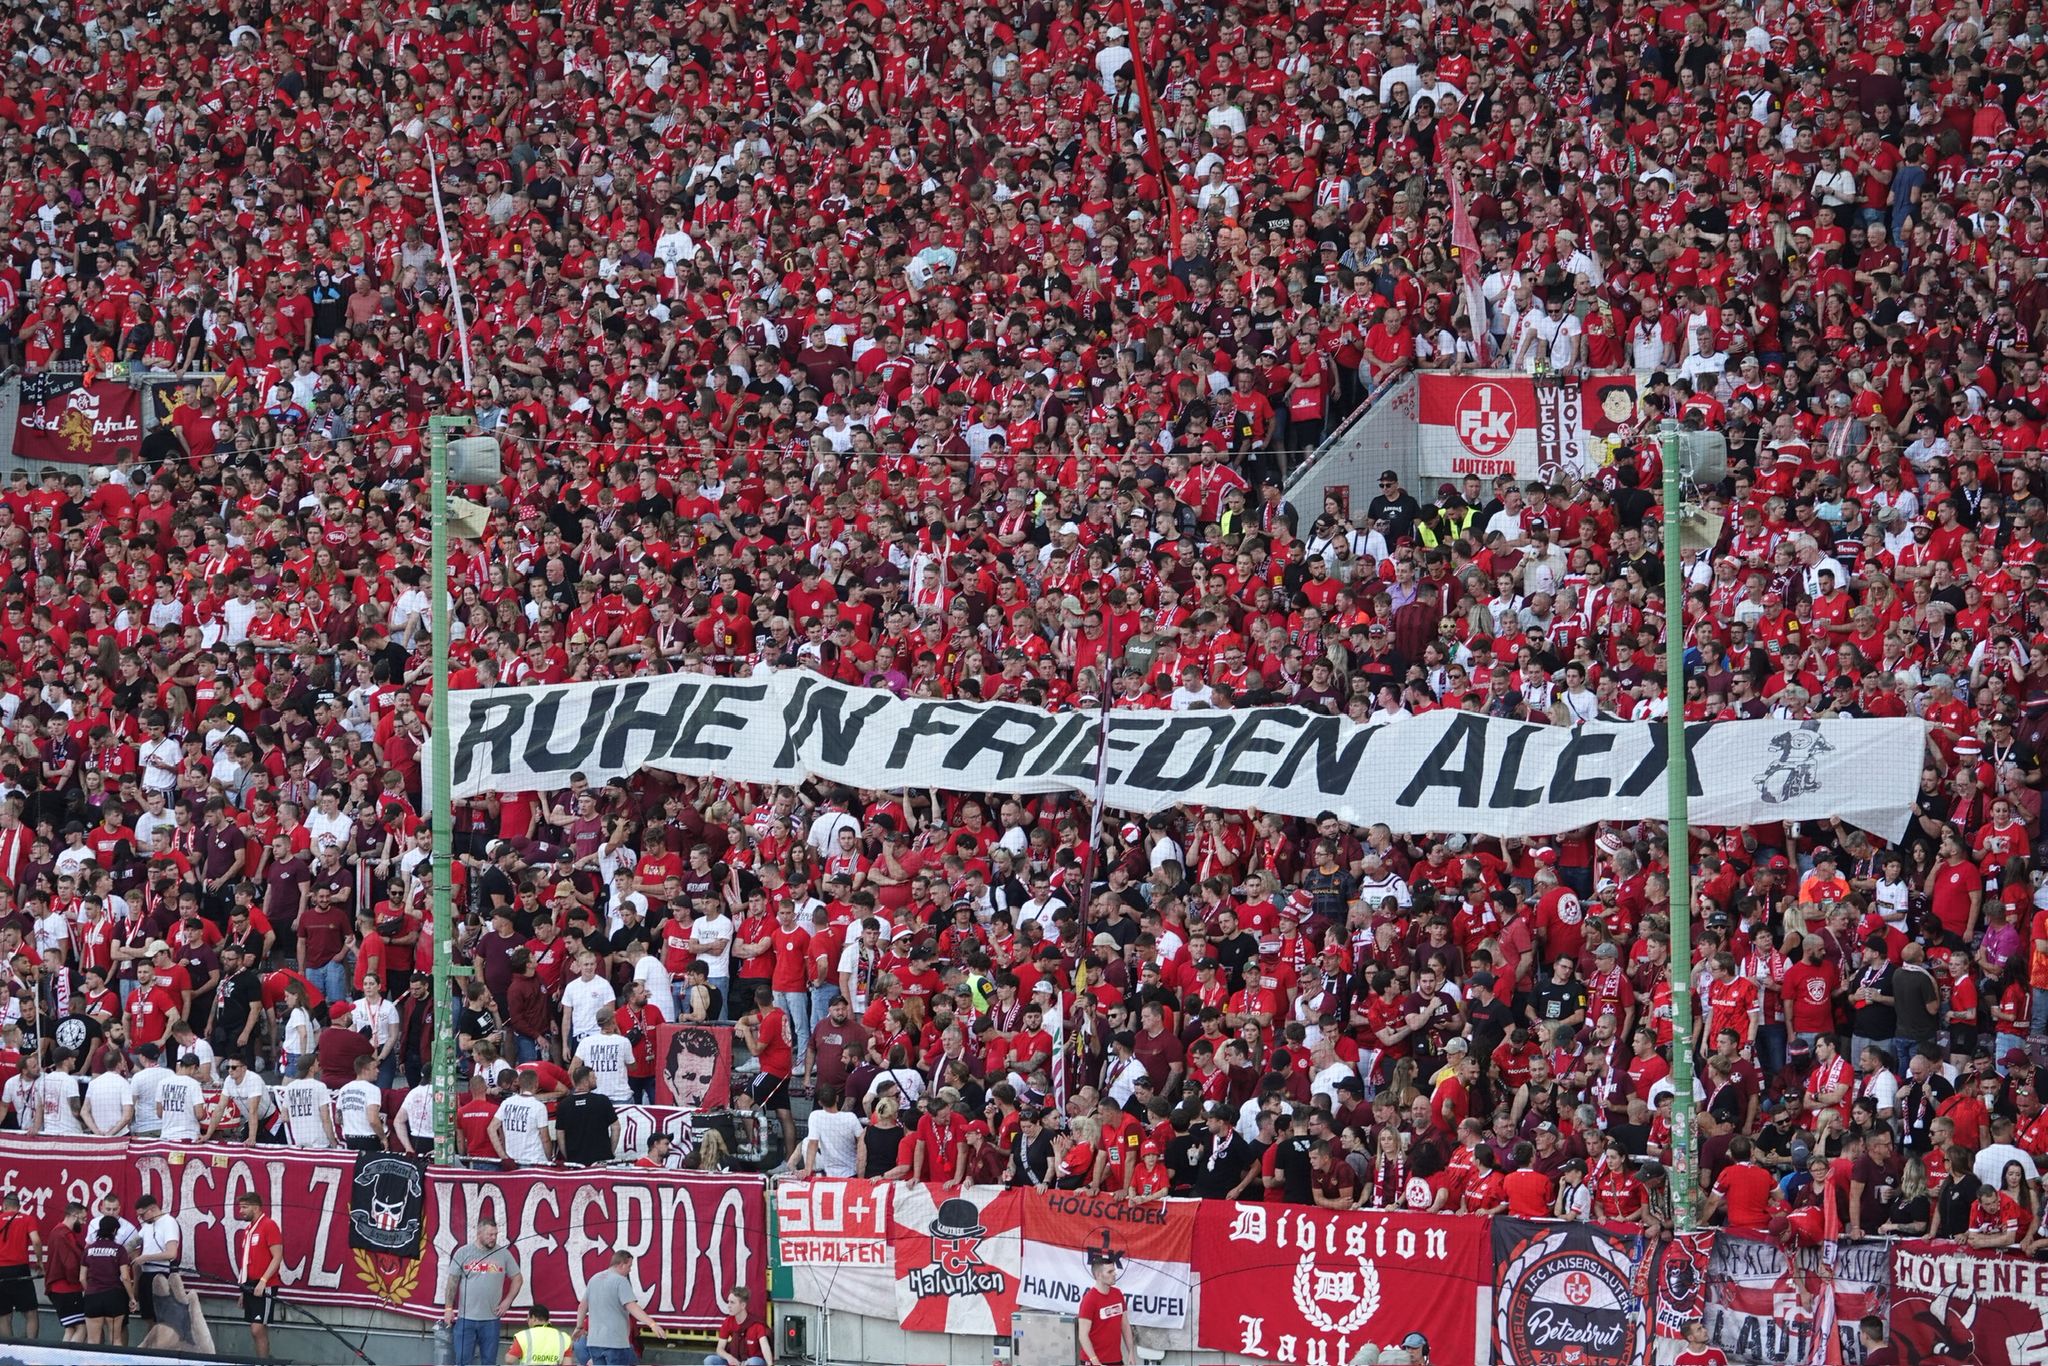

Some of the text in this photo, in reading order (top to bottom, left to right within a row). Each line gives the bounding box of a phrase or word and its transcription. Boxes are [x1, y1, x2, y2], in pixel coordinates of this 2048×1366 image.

[1478, 387, 1491, 412] 1
[1563, 384, 1579, 458] BOYS
[1537, 386, 1557, 460] WEST
[1452, 457, 1517, 475] LAUTERTAL
[453, 677, 1711, 809] RUHE IN FRIEDEN ALEX
[432, 1181, 752, 1315] INFERNO
[1229, 1201, 1448, 1260] Division
[781, 1241, 886, 1265] ERHALTEN
[910, 1270, 1004, 1298] Halunken
[1527, 1307, 1624, 1351] Betzebrut
[532, 1354, 559, 1363] ORDNER
